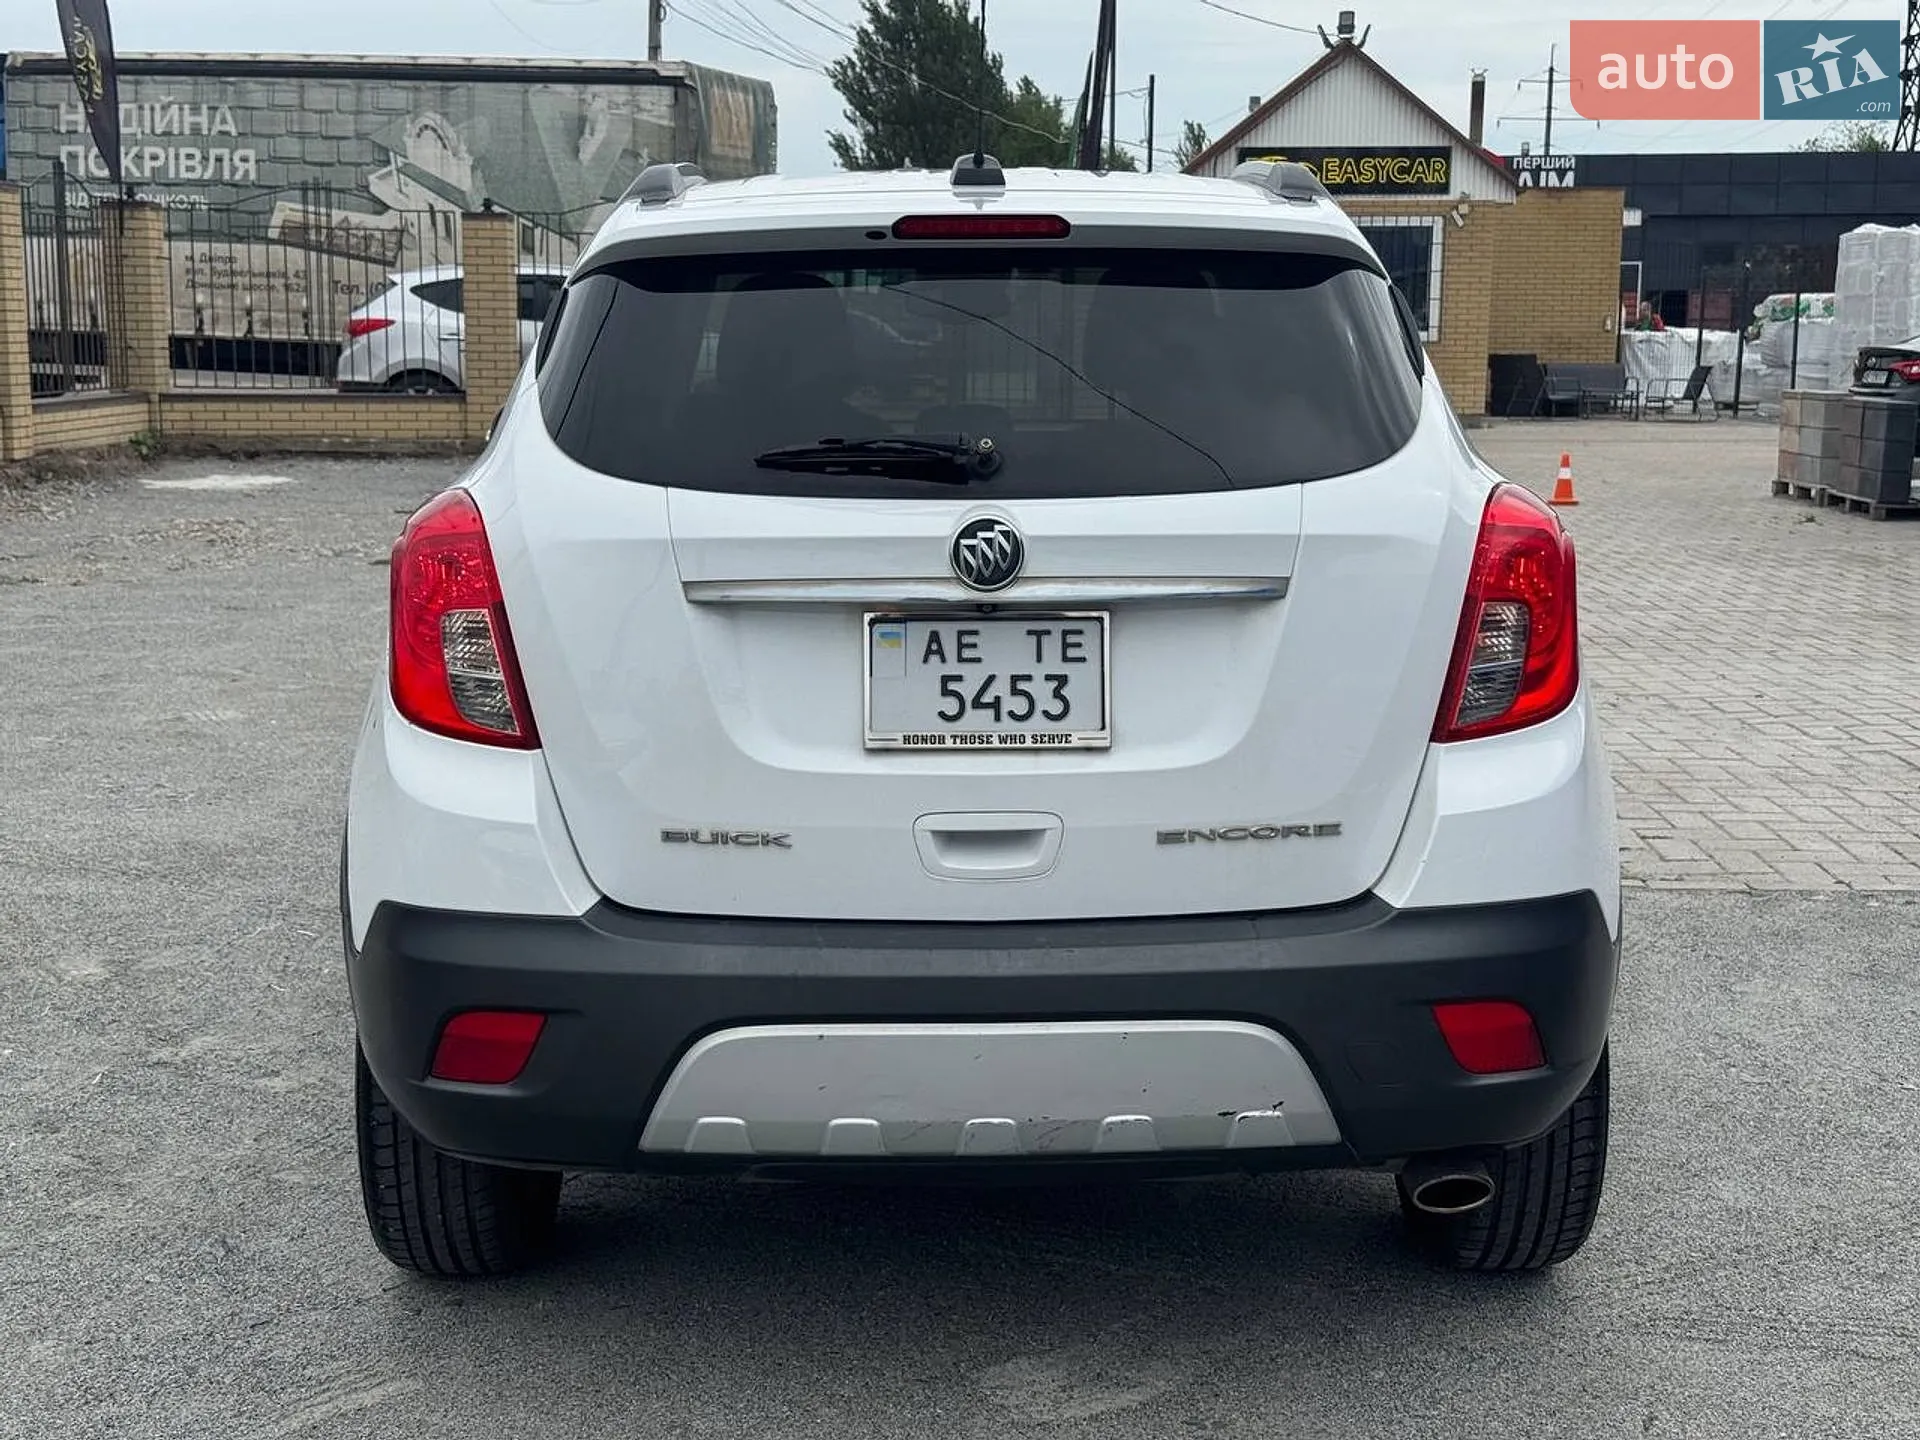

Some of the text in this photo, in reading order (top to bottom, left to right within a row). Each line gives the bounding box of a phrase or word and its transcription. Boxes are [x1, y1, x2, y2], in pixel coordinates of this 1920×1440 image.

[59, 96, 239, 139] НДІЙНА
[1322, 157, 1446, 184] EASYCAR
[1513, 155, 1576, 170] ПЕРШИЙ
[332, 279, 365, 295] Тел.
[922, 628, 1088, 664] AE TE
[937, 673, 1071, 723] 5453
[902, 733, 1073, 745] HONOR THOSE WHO SERVE
[660, 827, 793, 850] BUICK
[1156, 822, 1343, 846] ENCORE
